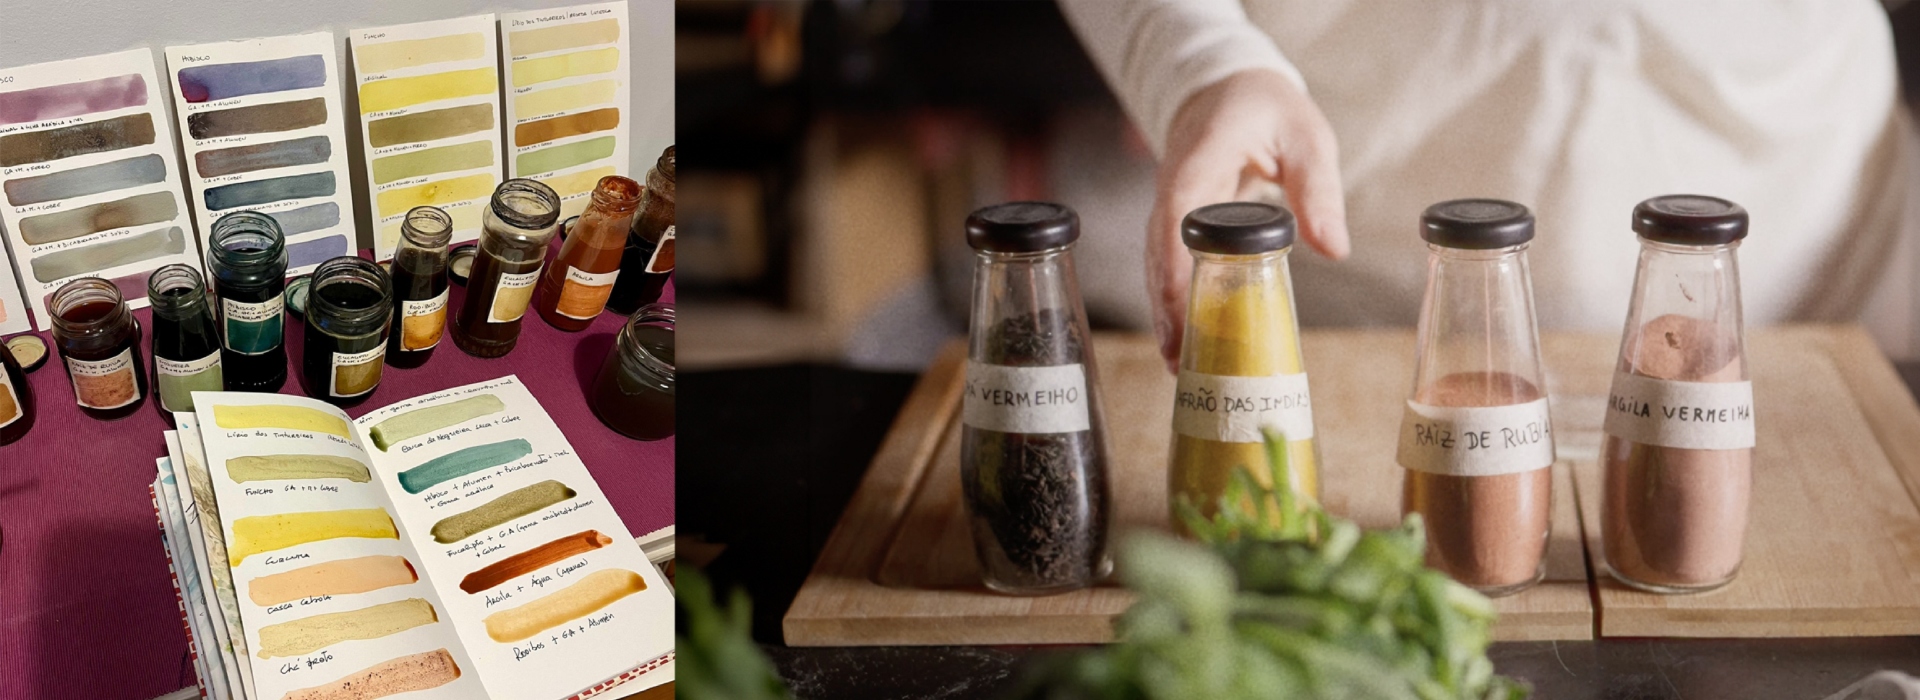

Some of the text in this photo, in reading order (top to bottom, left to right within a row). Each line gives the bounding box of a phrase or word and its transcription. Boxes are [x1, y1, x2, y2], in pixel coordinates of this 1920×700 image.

[1223, 396, 1254, 413] DAS
[1464, 431, 1490, 450] DE
[531, 575, 553, 587] Água
[556, 558, 588, 577] (apenas)
[512, 641, 545, 661] Rooibos
[551, 635, 559, 644] +
[579, 625, 585, 633] +
